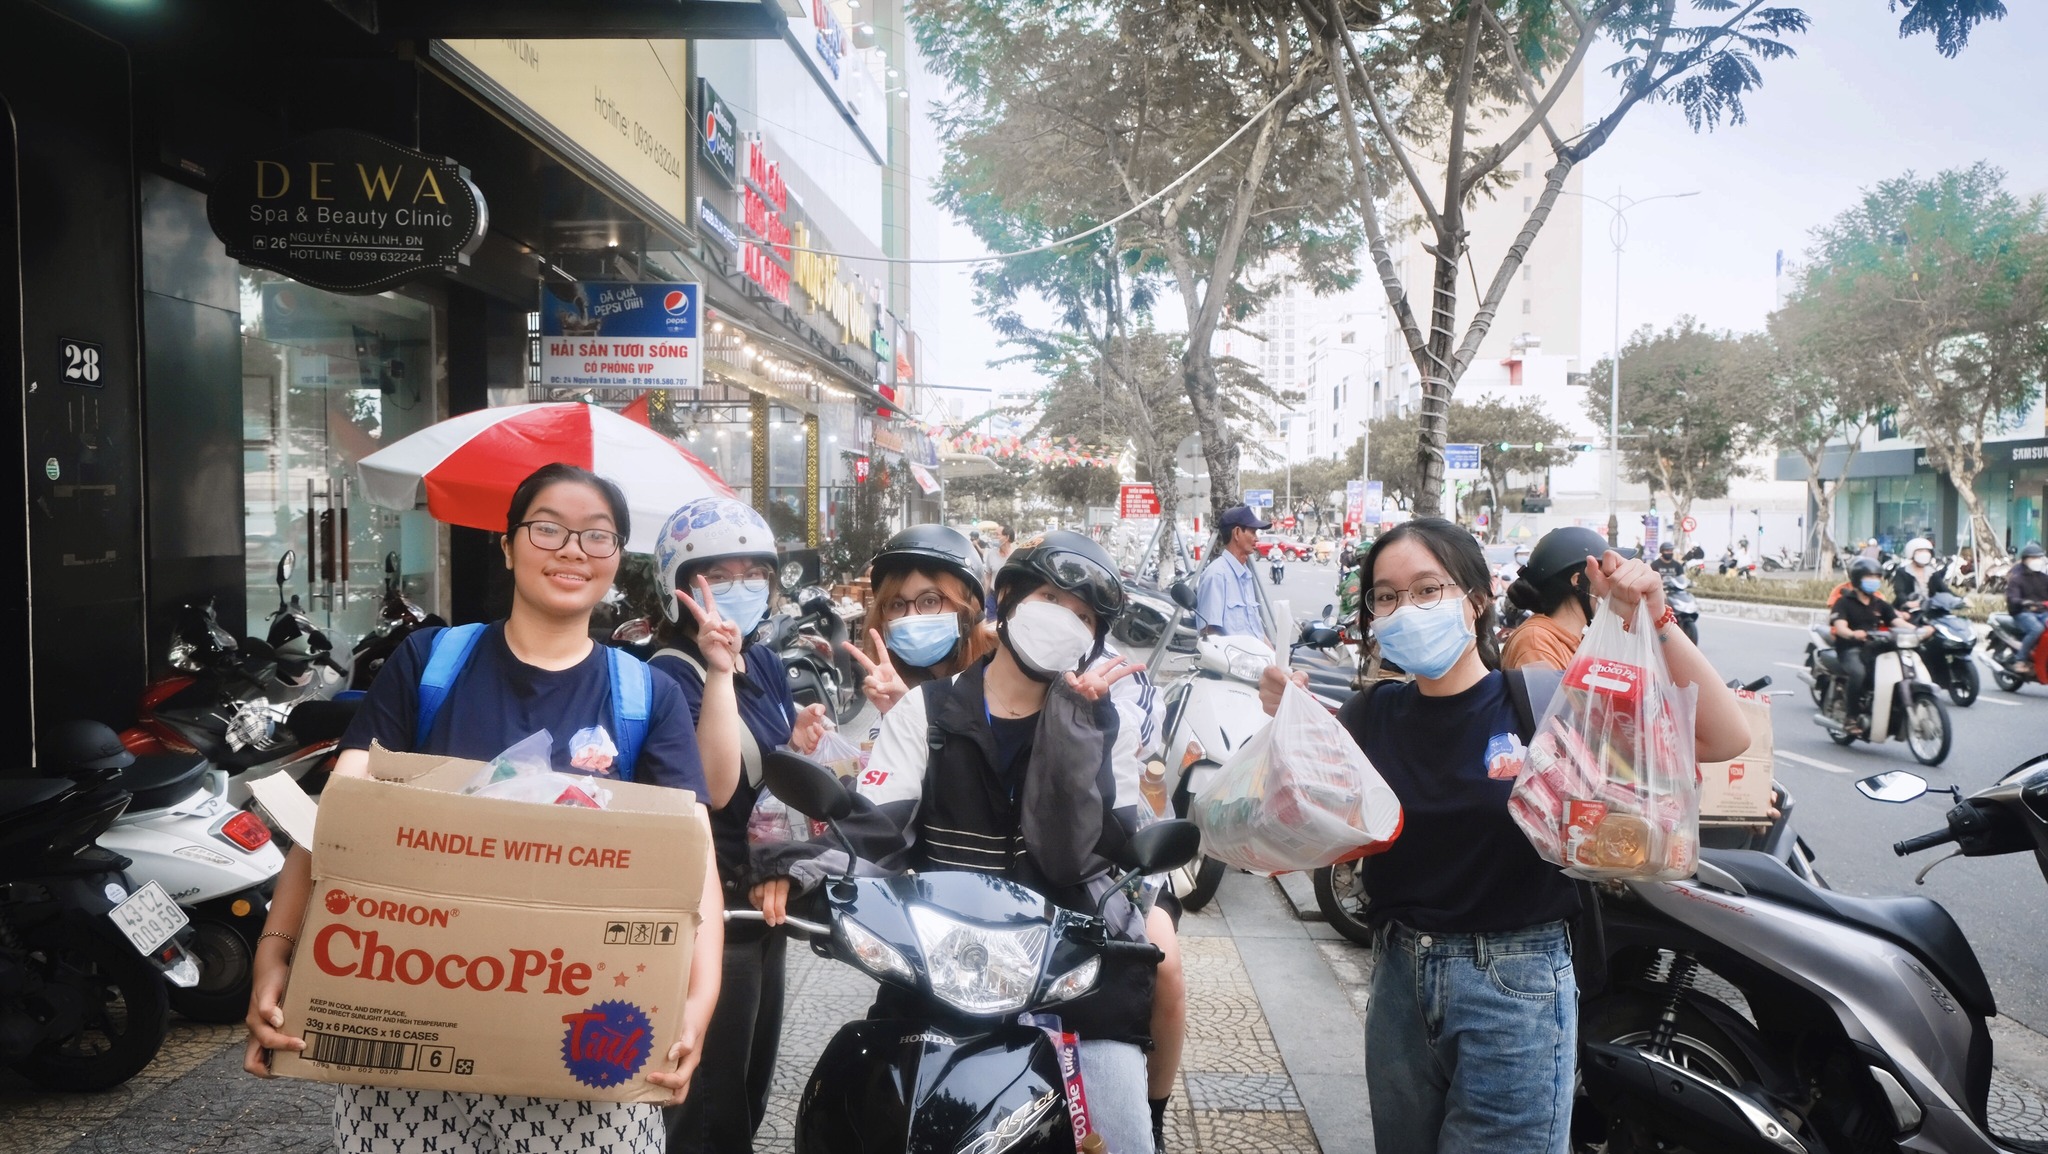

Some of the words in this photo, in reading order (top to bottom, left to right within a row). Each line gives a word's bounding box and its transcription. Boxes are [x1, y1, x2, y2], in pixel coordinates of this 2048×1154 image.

[594, 85, 631, 140] Hotline:
[633, 121, 653, 158] 0939
[654, 141, 680, 182] 632244
[716, 131, 735, 166] pepsi
[255, 160, 447, 205] DEWA
[250, 205, 289, 225] Spa
[296, 206, 309, 223] &
[317, 206, 387, 229] Beauty
[395, 208, 453, 227] Clinic
[270, 236, 287, 249] 26
[290, 228, 341, 244] NGUYỄN
[344, 231, 369, 245] VĂN
[372, 234, 402, 247] LINH,
[405, 235, 423, 246] ĐN
[290, 250, 345, 261] HOTLINE:
[349, 251, 378, 262] 0939
[380, 252, 422, 263] 632244
[616, 285, 637, 301] QUÁ
[594, 302, 622, 317] PEPSI
[551, 339, 574, 356] HẢI
[579, 339, 608, 357] SẢN
[613, 343, 644, 357] TƯƠI
[649, 340, 688, 358] SỐNG
[65, 344, 100, 382] 28
[584, 361, 597, 373] CÓ
[600, 360, 635, 374] PHÒNG
[638, 363, 654, 374] VIP
[563, 376, 572, 384] 24
[612, 376, 627, 385] Linh
[1588, 663, 1622, 675] Choco
[396, 827, 497, 859] HANDLE
[504, 839, 562, 865] WITH
[567, 845, 632, 870] CARE
[119, 888, 164, 928] 43-C2
[356, 897, 450, 929] ORION
[131, 904, 184, 952] 009.59
[308, 1005, 327, 1014] AVOID
[327, 1008, 351, 1018] DIRECT
[350, 1012, 382, 1022] SUNLIGHT
[382, 1015, 396, 1024] AND
[396, 1017, 413, 1026] HIGH
[413, 1019, 458, 1029] TEMPERATURE
[310, 998, 328, 1007] KEEP
[328, 1000, 335, 1008] IN
[335, 1002, 353, 1011] COOL
[354, 1005, 369, 1014] AND
[370, 1007, 383, 1015] DRY
[383, 1009, 407, 1018] PLACE,
[306, 1017, 324, 1031] 33g
[326, 1022, 332, 1031] x
[333, 1021, 340, 1032] 6
[341, 1023, 379, 1037] PACKS
[380, 1029, 387, 1037] x
[389, 1028, 401, 1039] 16
[402, 1030, 439, 1042] CASES
[899, 1033, 957, 1047] HONDA
[429, 1049, 443, 1068] 6
